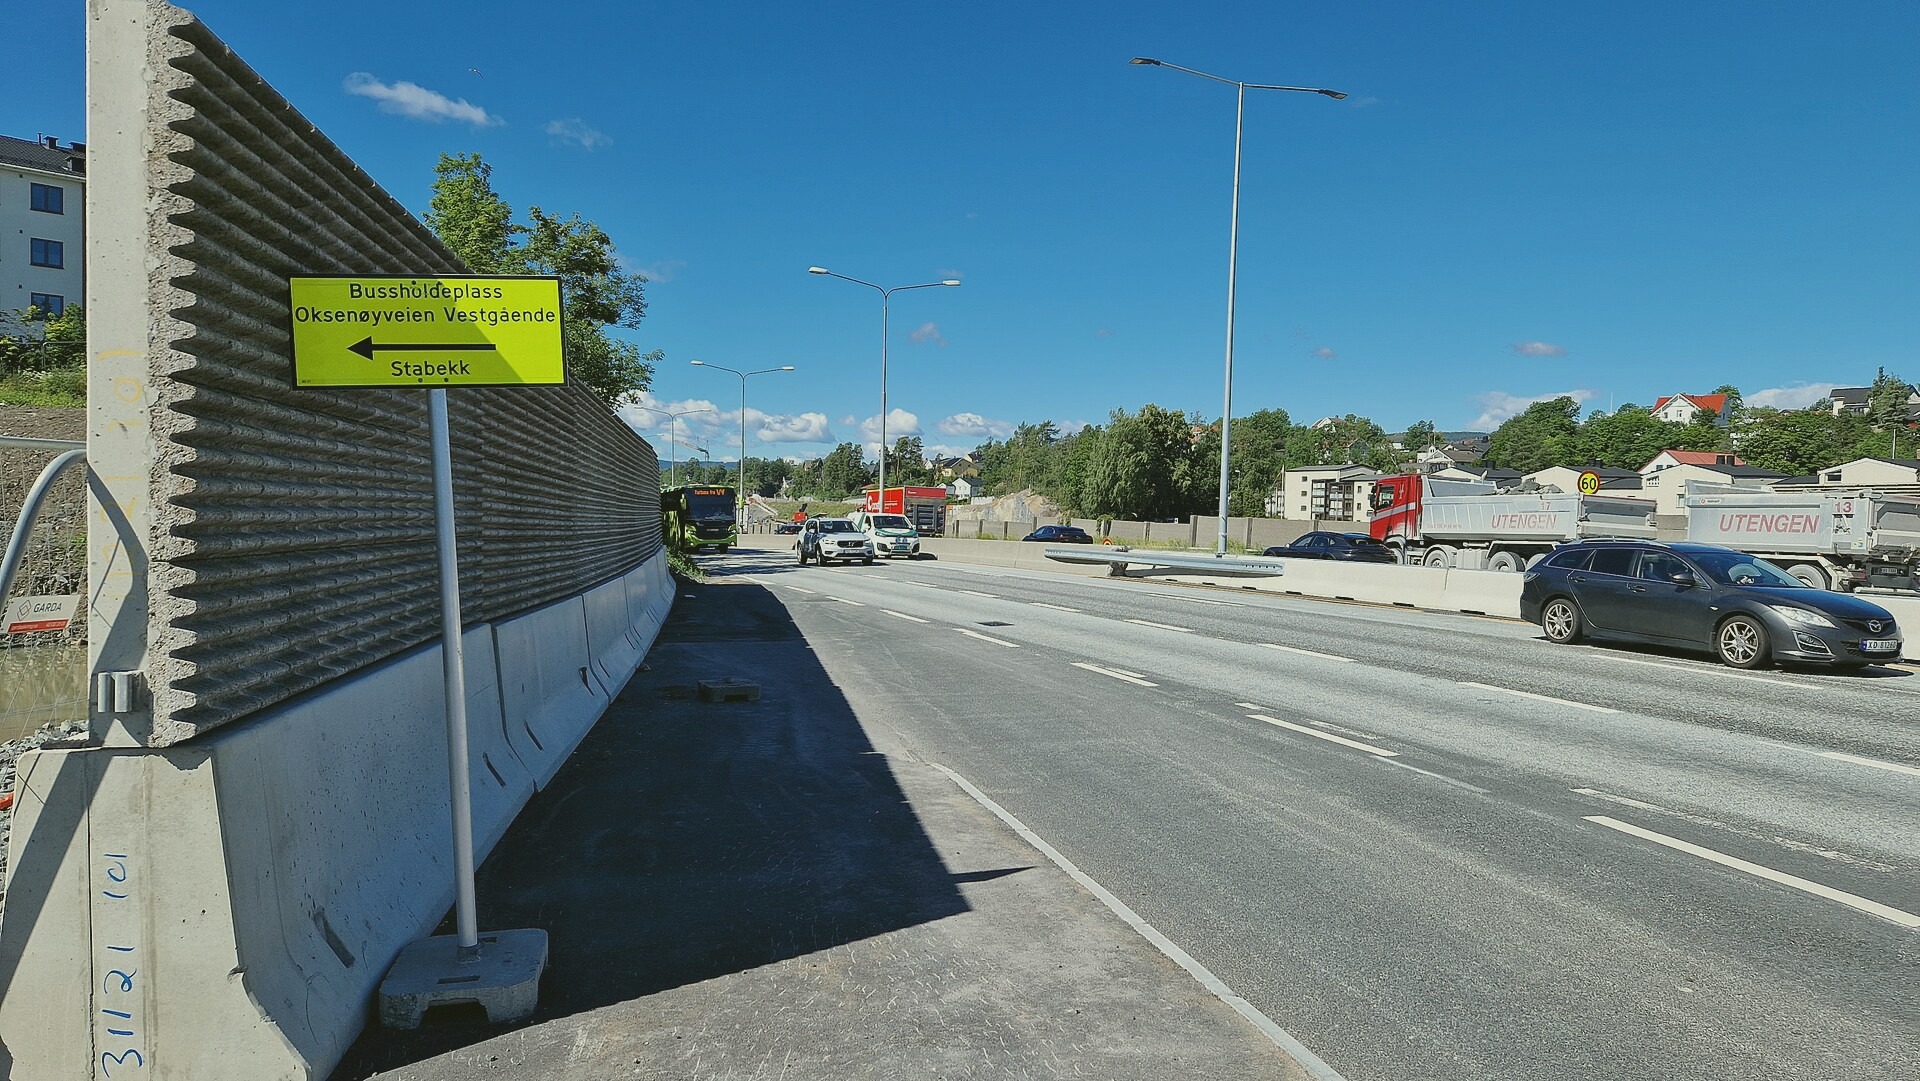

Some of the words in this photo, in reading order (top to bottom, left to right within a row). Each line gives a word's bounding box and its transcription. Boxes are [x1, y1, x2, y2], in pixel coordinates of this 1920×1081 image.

[350, 283, 503, 302] Bussholdeplass
[295, 306, 435, 326] Oksenøyveien
[443, 306, 556, 326] Vestgående
[391, 360, 470, 377] Stabekk
[1582, 477, 1597, 490] 60
[1541, 501, 1551, 511] 17
[1834, 501, 1852, 513] 13
[1491, 514, 1557, 529] UTENGEN
[1719, 514, 1820, 533] UTENGEN
[33, 602, 62, 613] GARDA
